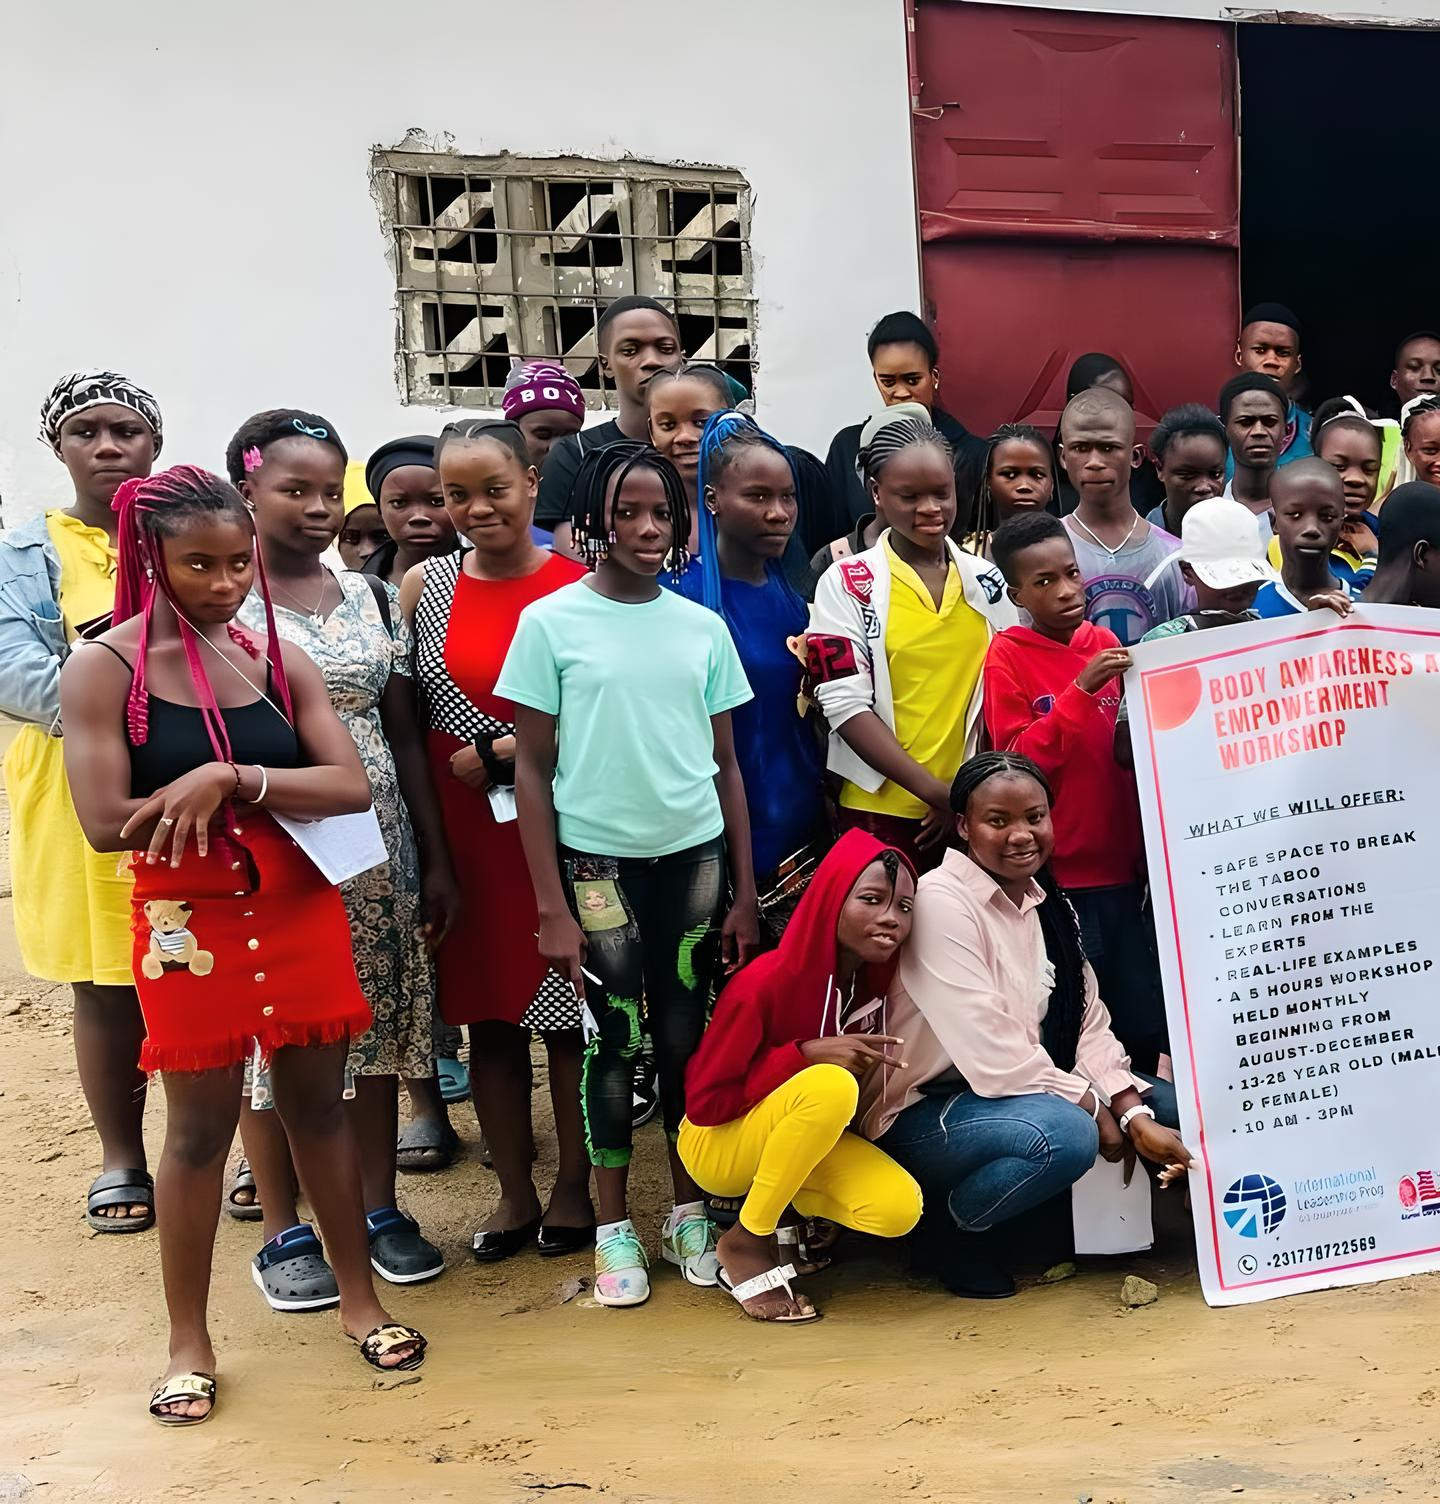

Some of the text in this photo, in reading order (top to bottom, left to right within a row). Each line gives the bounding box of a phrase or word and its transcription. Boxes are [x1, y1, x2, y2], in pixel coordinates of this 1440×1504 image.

[520, 387, 578, 405] BOY
[1208, 666, 1266, 704] BODY
[1280, 647, 1413, 689] AWARENESS
[1214, 680, 1390, 738] EMPOWERMENT
[1218, 719, 1346, 770] WORKSHOP
[1189, 788, 1406, 838] WHAT WE WILL OFFER:
[1213, 830, 1417, 876] SAFE SPACE TO BREAK
[1216, 866, 1321, 897] THE TABOO
[1219, 881, 1367, 917] CONVERSATIONS
[1222, 902, 1375, 939] LEARN FROM THE
[1224, 935, 1306, 960] EXPERTS
[1227, 940, 1418, 981] REAL-LIFE EXAMPLES
[1229, 991, 1241, 1002] A
[1267, 976, 1324, 997] HOURS
[1330, 959, 1434, 986] WORKSHOP
[1232, 990, 1370, 1025] HELD MONTHLY
[1341, 1009, 1391, 1028] FROM
[1238, 1028, 1415, 1069] AUGUST-DECEMBER
[1293, 1062, 1341, 1080] YEAR
[1348, 1055, 1384, 1071] OLD
[1261, 1084, 1339, 1109] FEMALE)
[1244, 1120, 1265, 1134] 10
